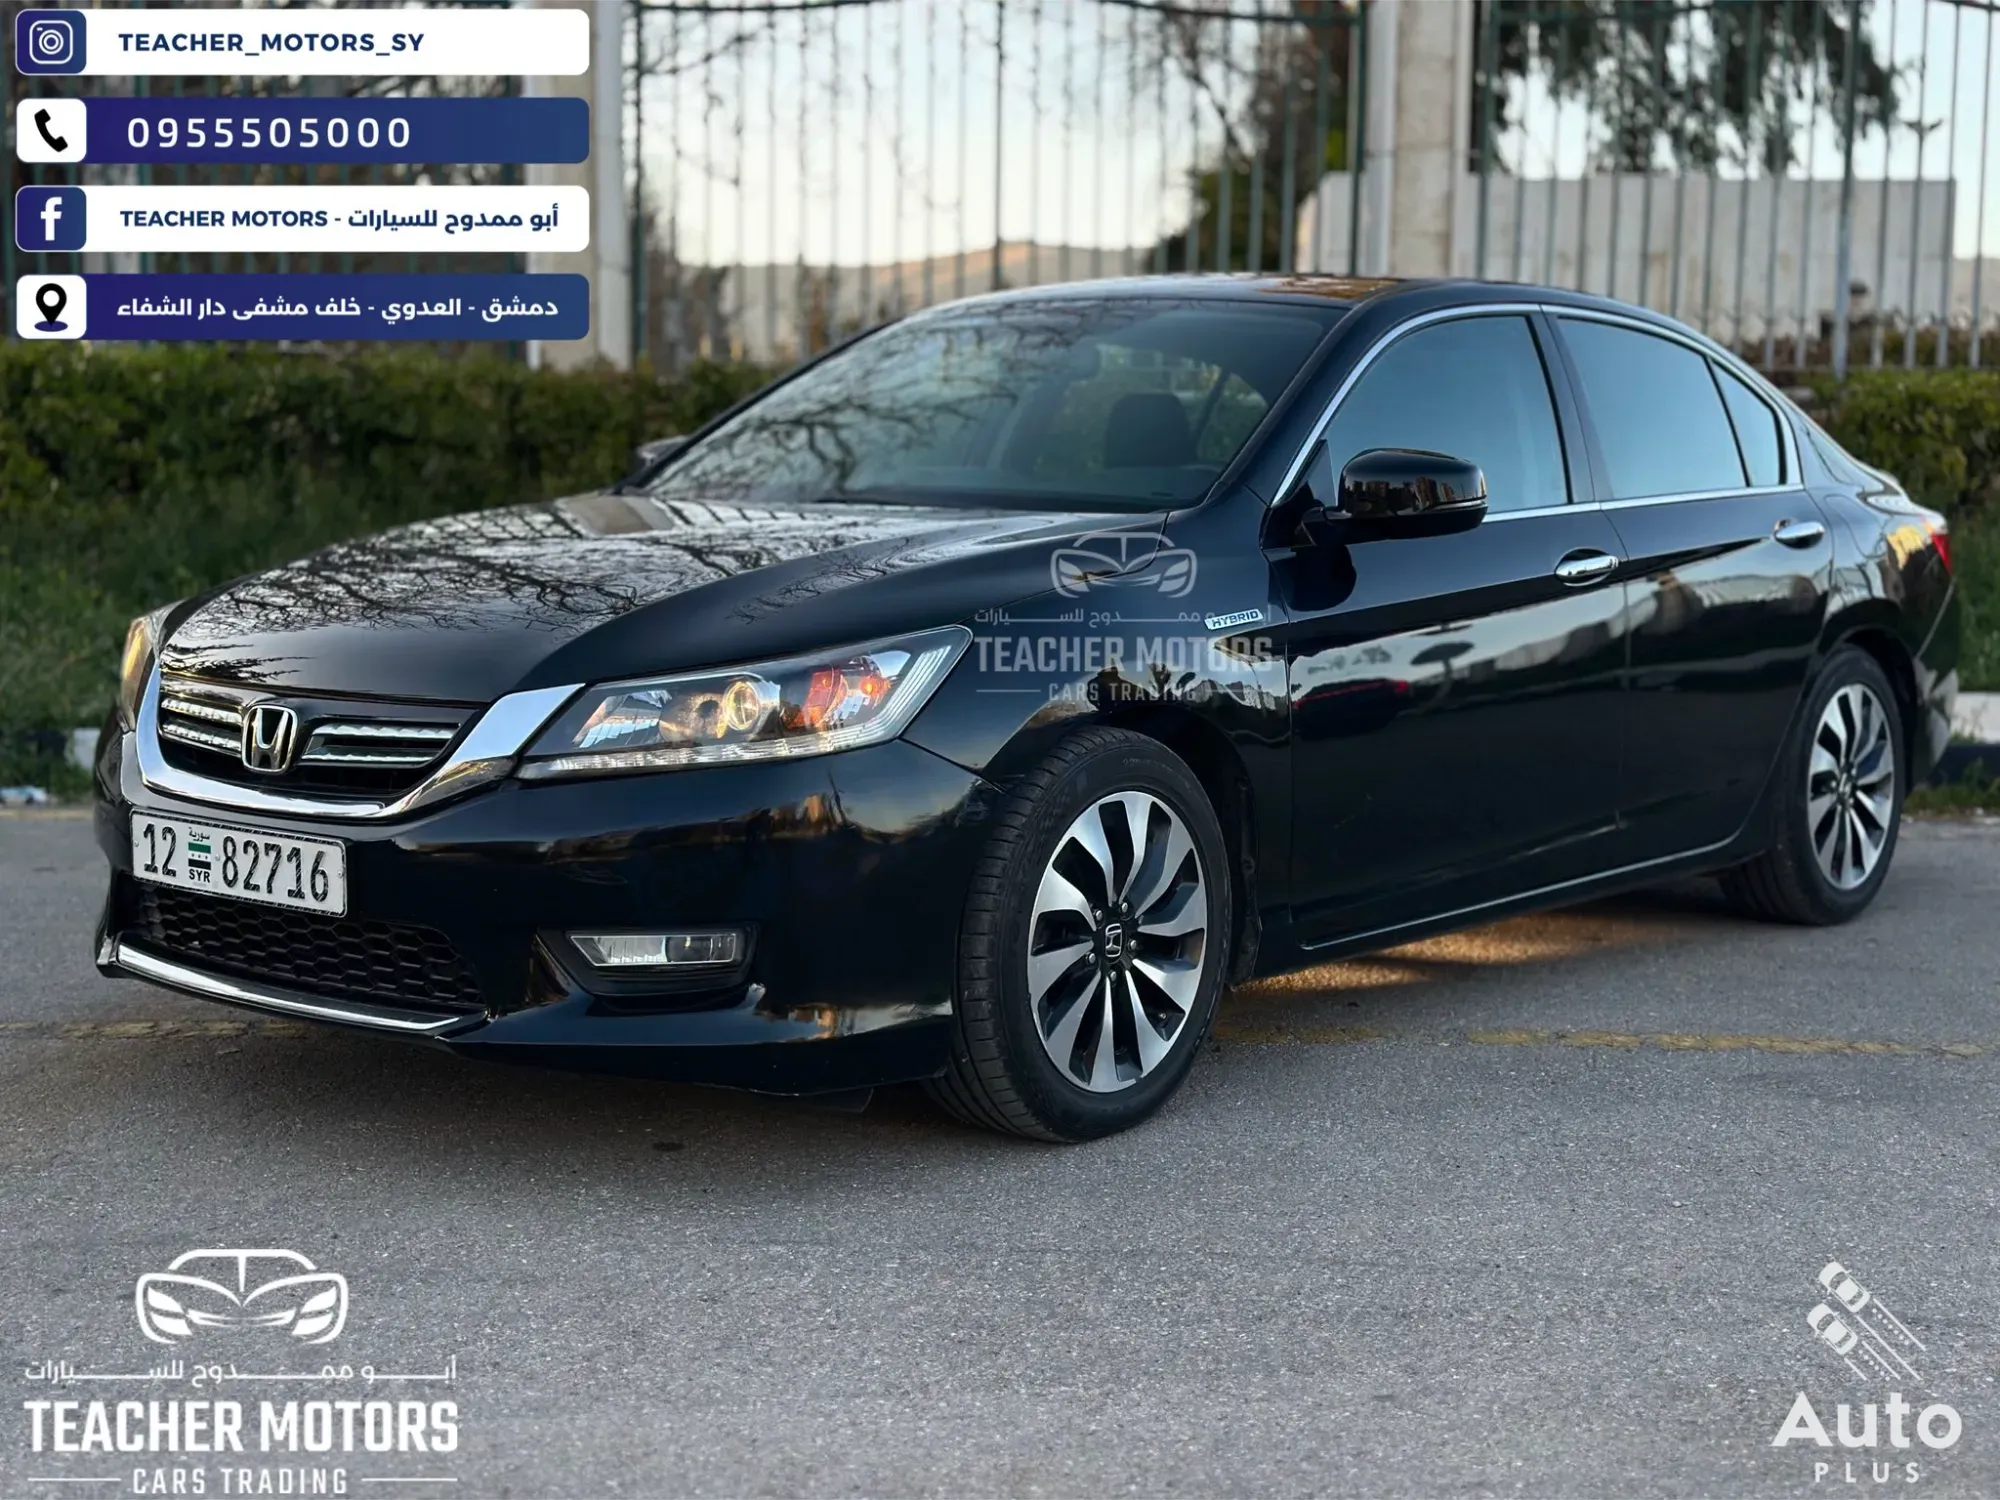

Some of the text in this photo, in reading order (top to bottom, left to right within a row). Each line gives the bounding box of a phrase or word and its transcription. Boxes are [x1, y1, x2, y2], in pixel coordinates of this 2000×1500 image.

[1211, 610, 1259, 628] HYBRID
[143, 823, 330, 902] 12 82716
[188, 868, 211, 883] SYR
